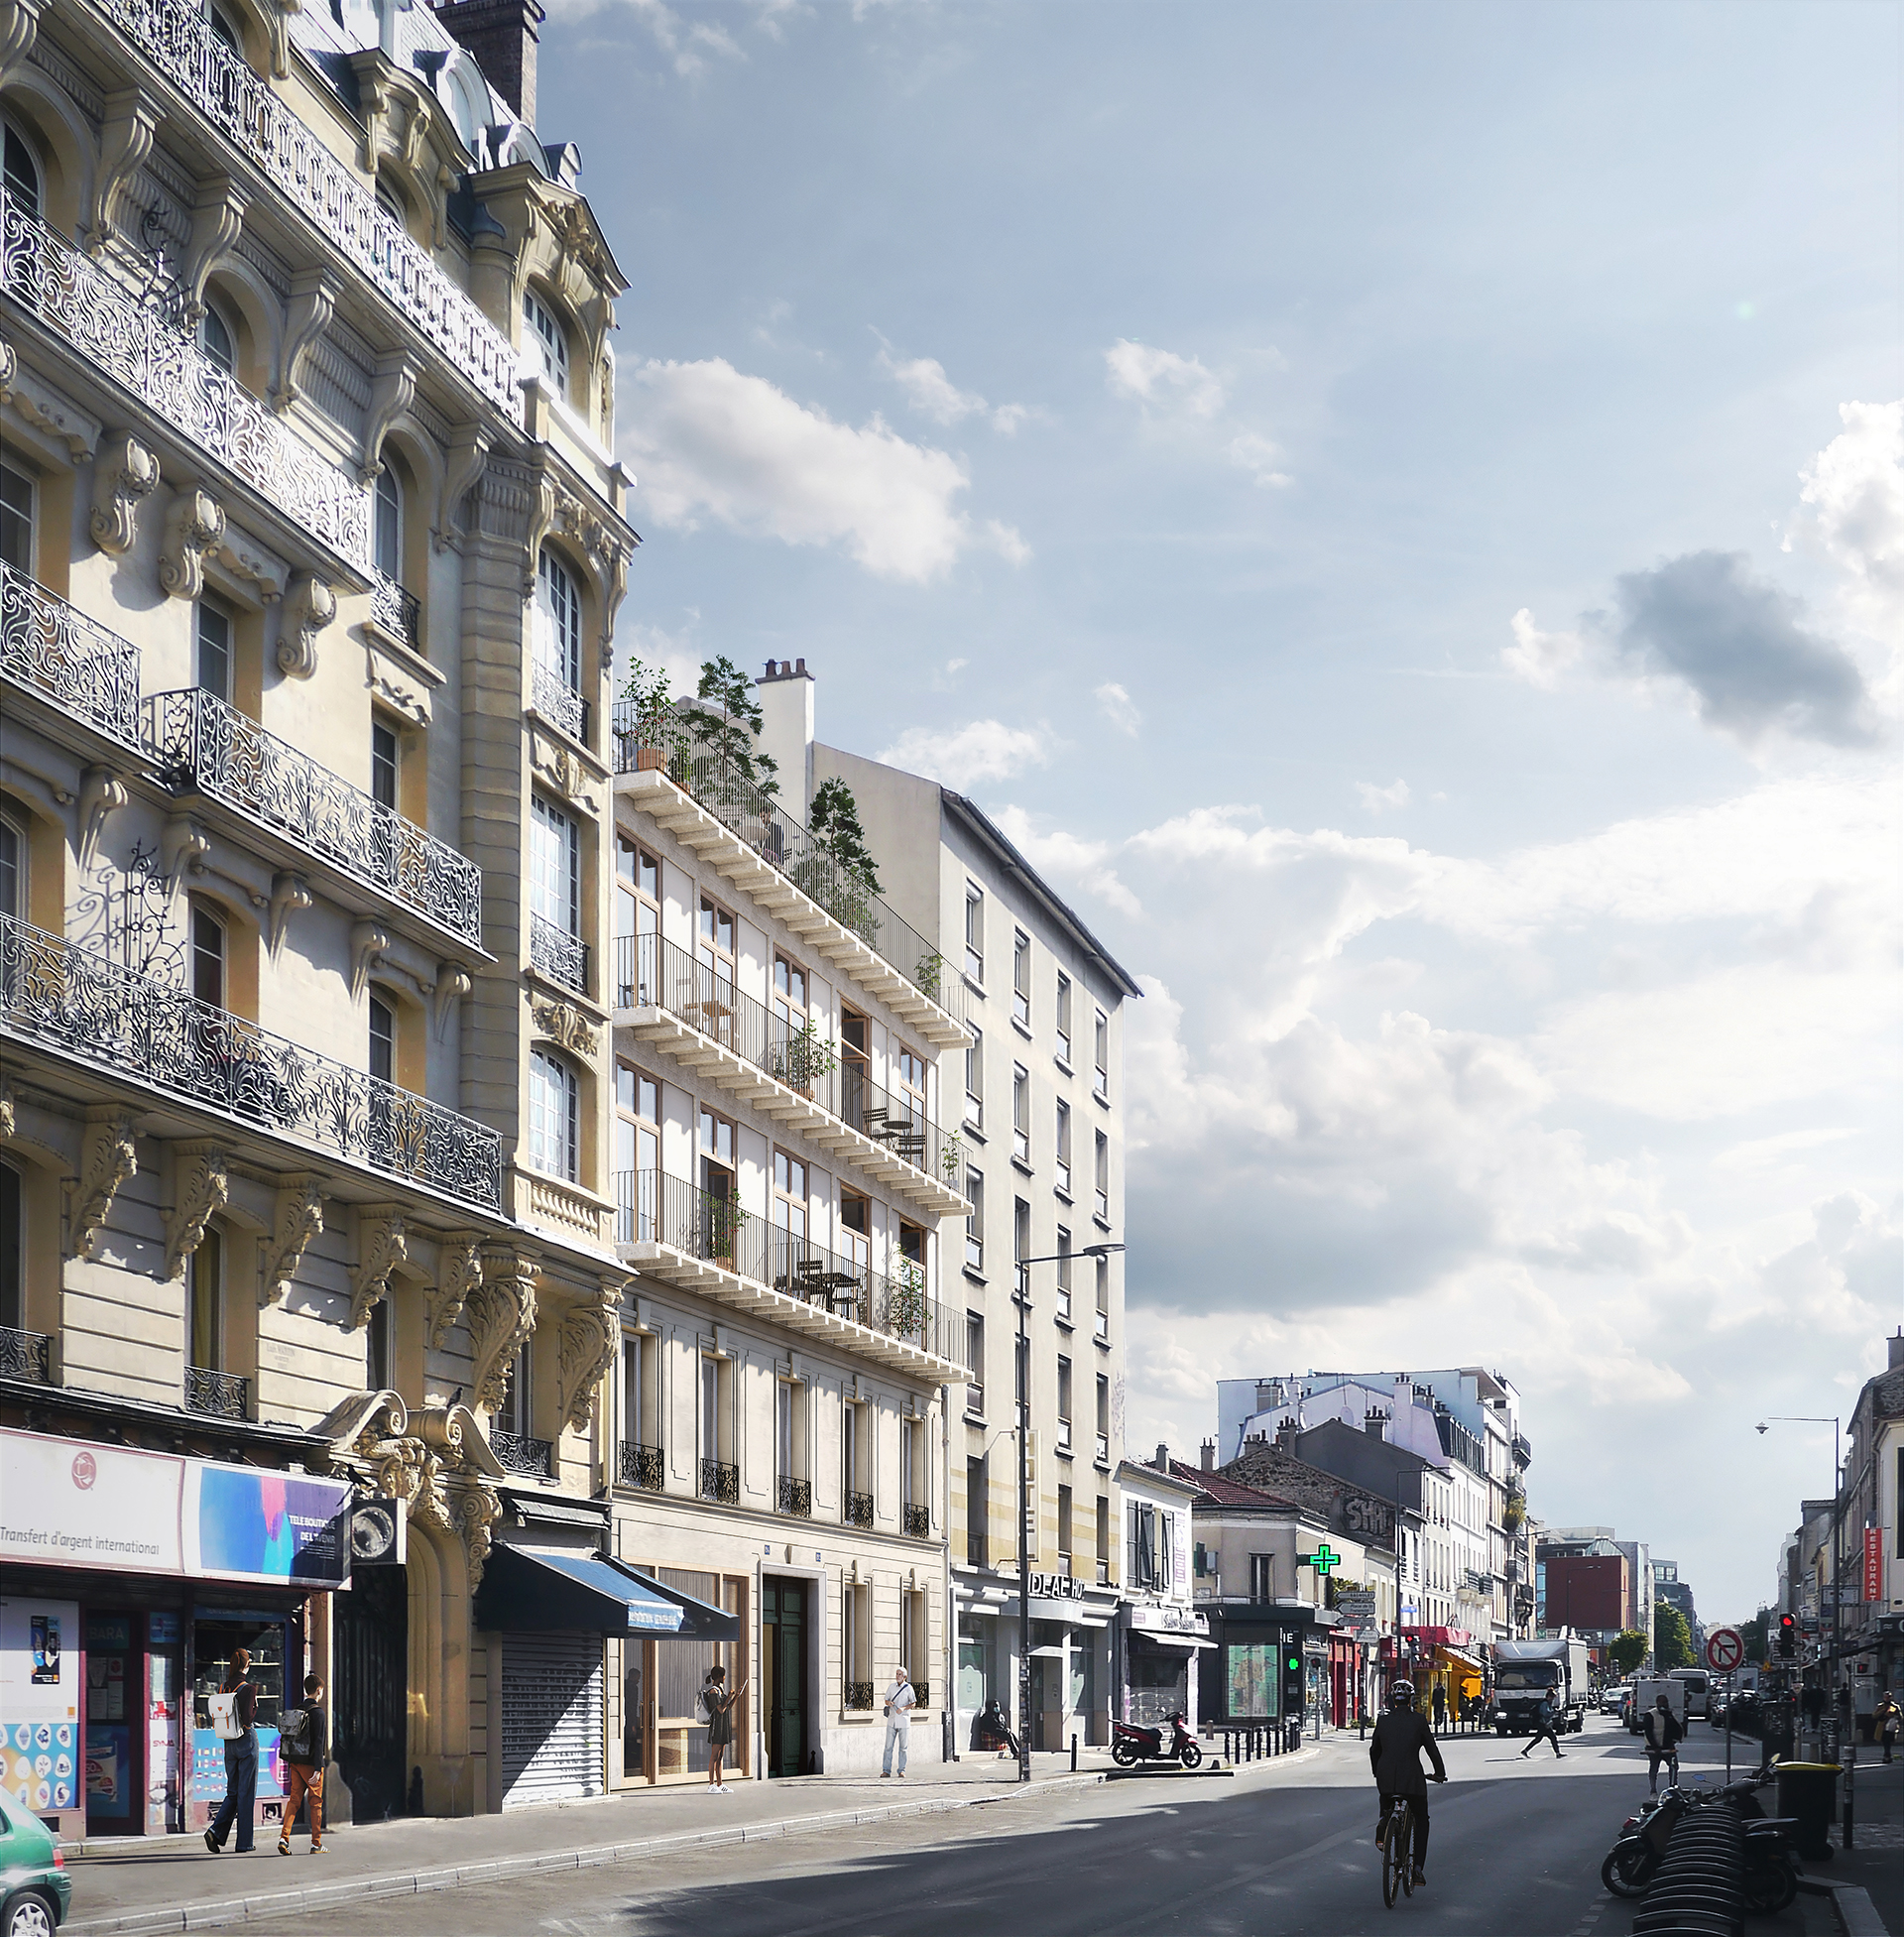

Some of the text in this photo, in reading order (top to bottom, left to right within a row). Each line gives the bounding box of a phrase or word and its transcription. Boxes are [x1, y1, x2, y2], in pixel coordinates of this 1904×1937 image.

[0, 1526, 160, 1555] Transfert d'argent international
[1282, 1633, 1294, 1643] IE
